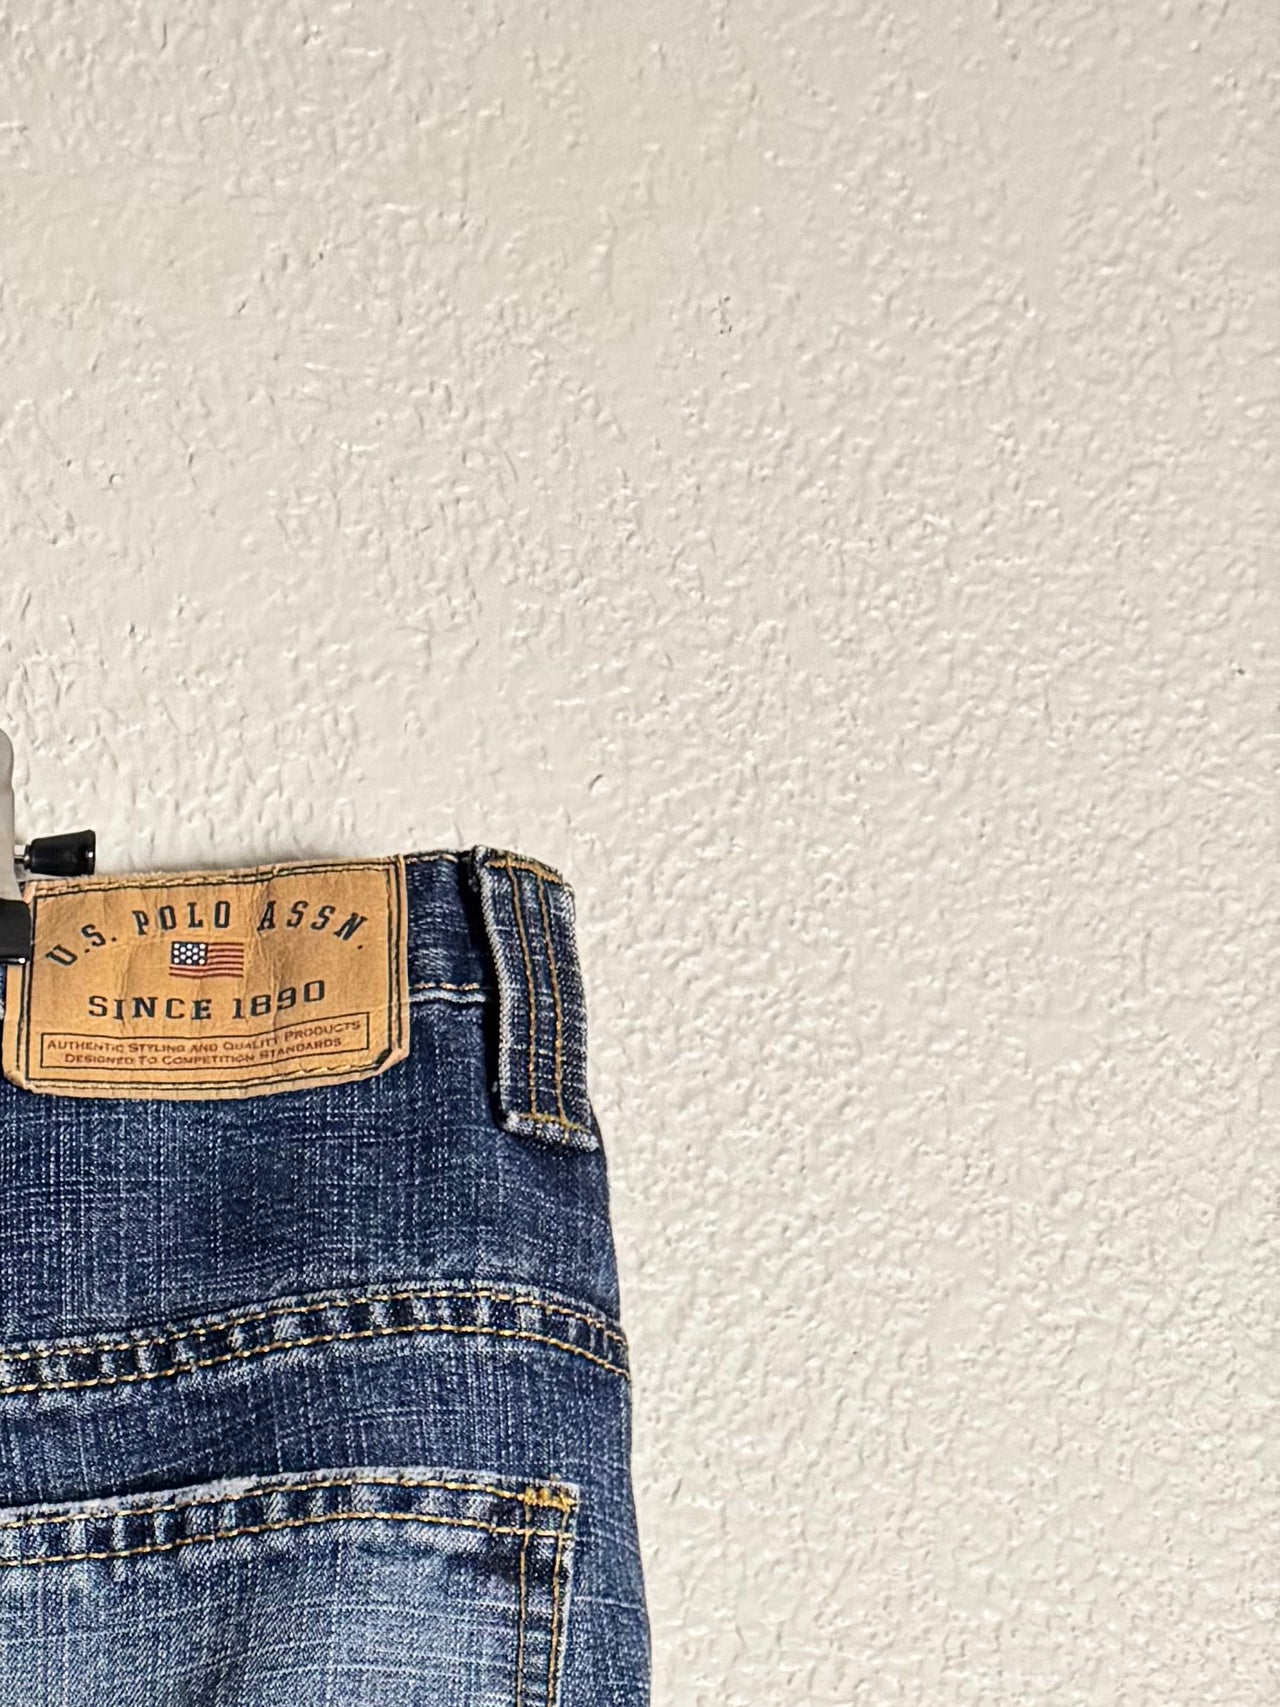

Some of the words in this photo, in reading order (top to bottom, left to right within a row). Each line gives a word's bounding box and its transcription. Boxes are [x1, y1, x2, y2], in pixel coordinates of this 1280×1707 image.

[46, 922, 117, 967] U.S.
[132, 900, 231, 935] POLO
[257, 900, 368, 950] ASSN.
[88, 995, 212, 1021] SINCE
[232, 979, 326, 1020] 1890
[64, 1053, 134, 1065] DESIGNED
[137, 1055, 157, 1065] TO
[162, 1053, 255, 1066] COMPETITION
[259, 1038, 342, 1060] STANDARDS
[128, 1043, 186, 1053] STYLING
[191, 1042, 218, 1052] AND
[284, 1020, 361, 1042] PRODUCTS
